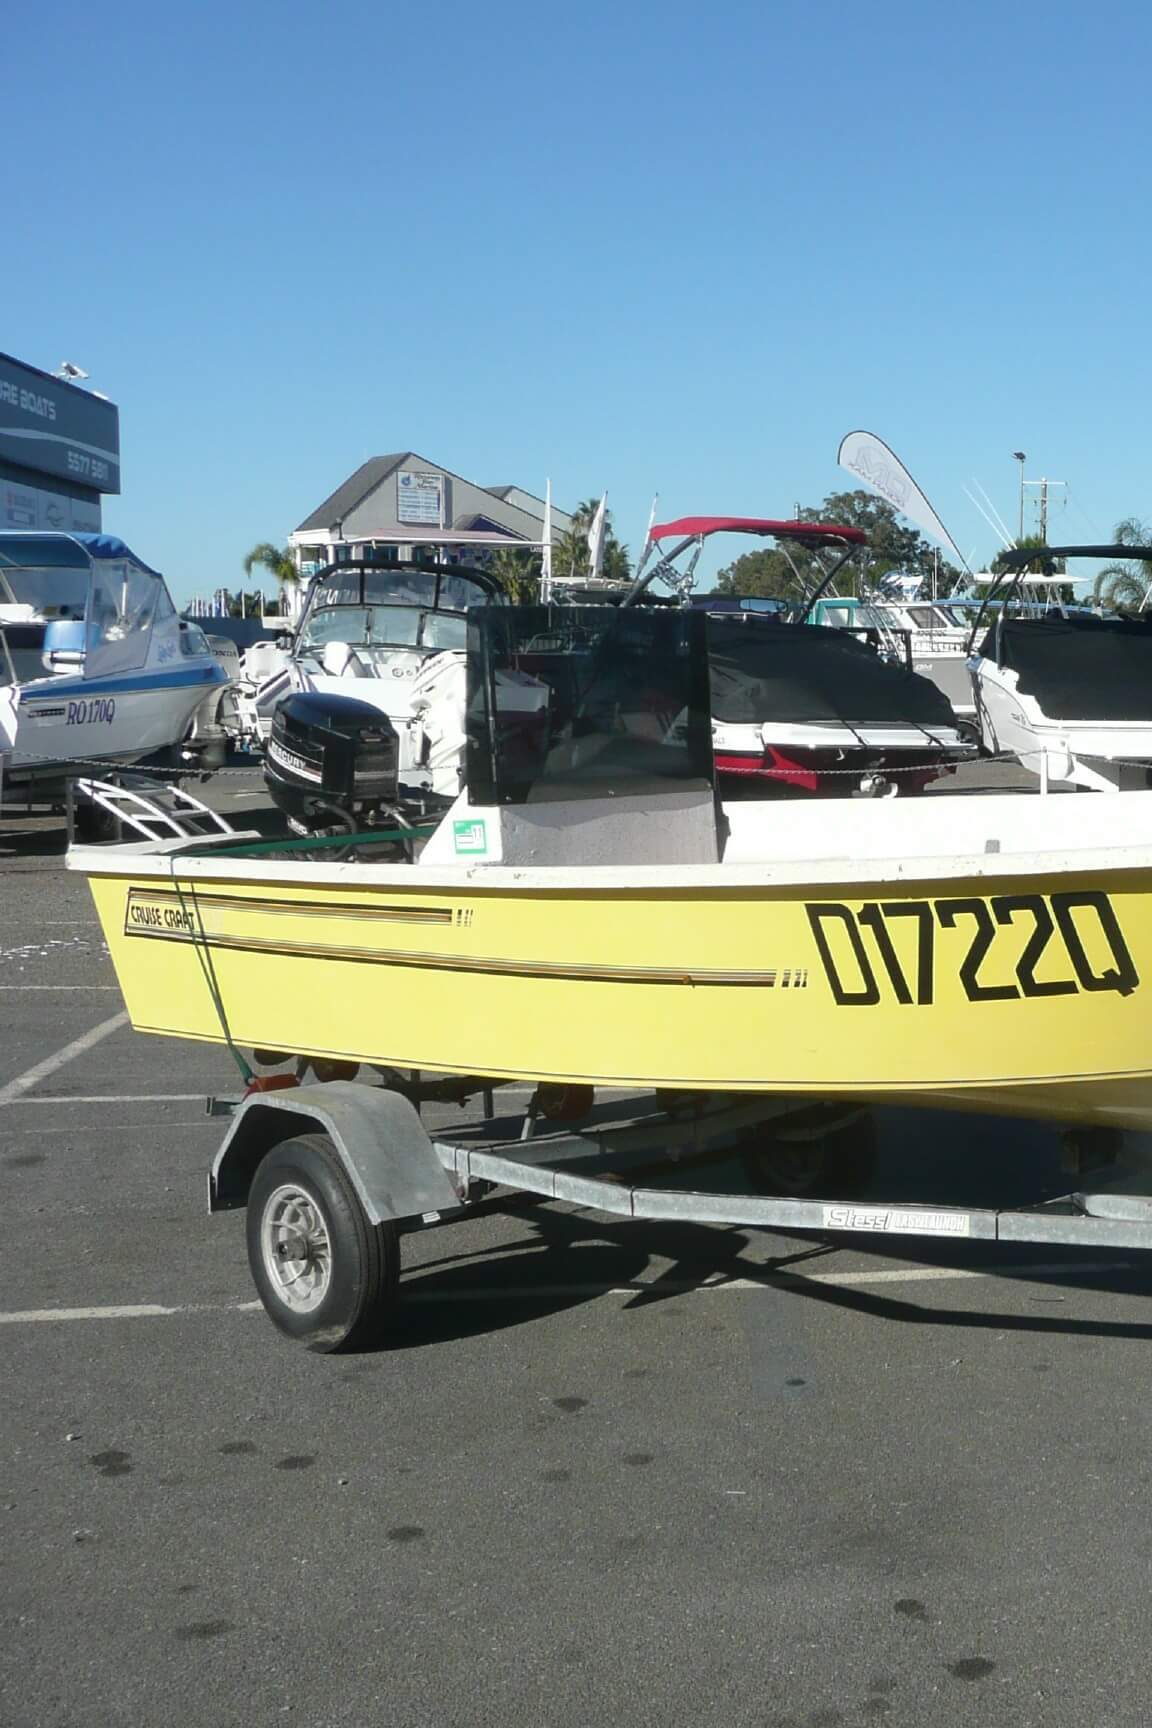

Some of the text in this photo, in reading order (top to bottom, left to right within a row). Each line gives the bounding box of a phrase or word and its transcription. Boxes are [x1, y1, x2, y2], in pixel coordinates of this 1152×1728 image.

[20, 389, 56, 420] BOATS
[131, 905, 163, 927] CRUISE
[804, 890, 1140, 1006] D1722Q
